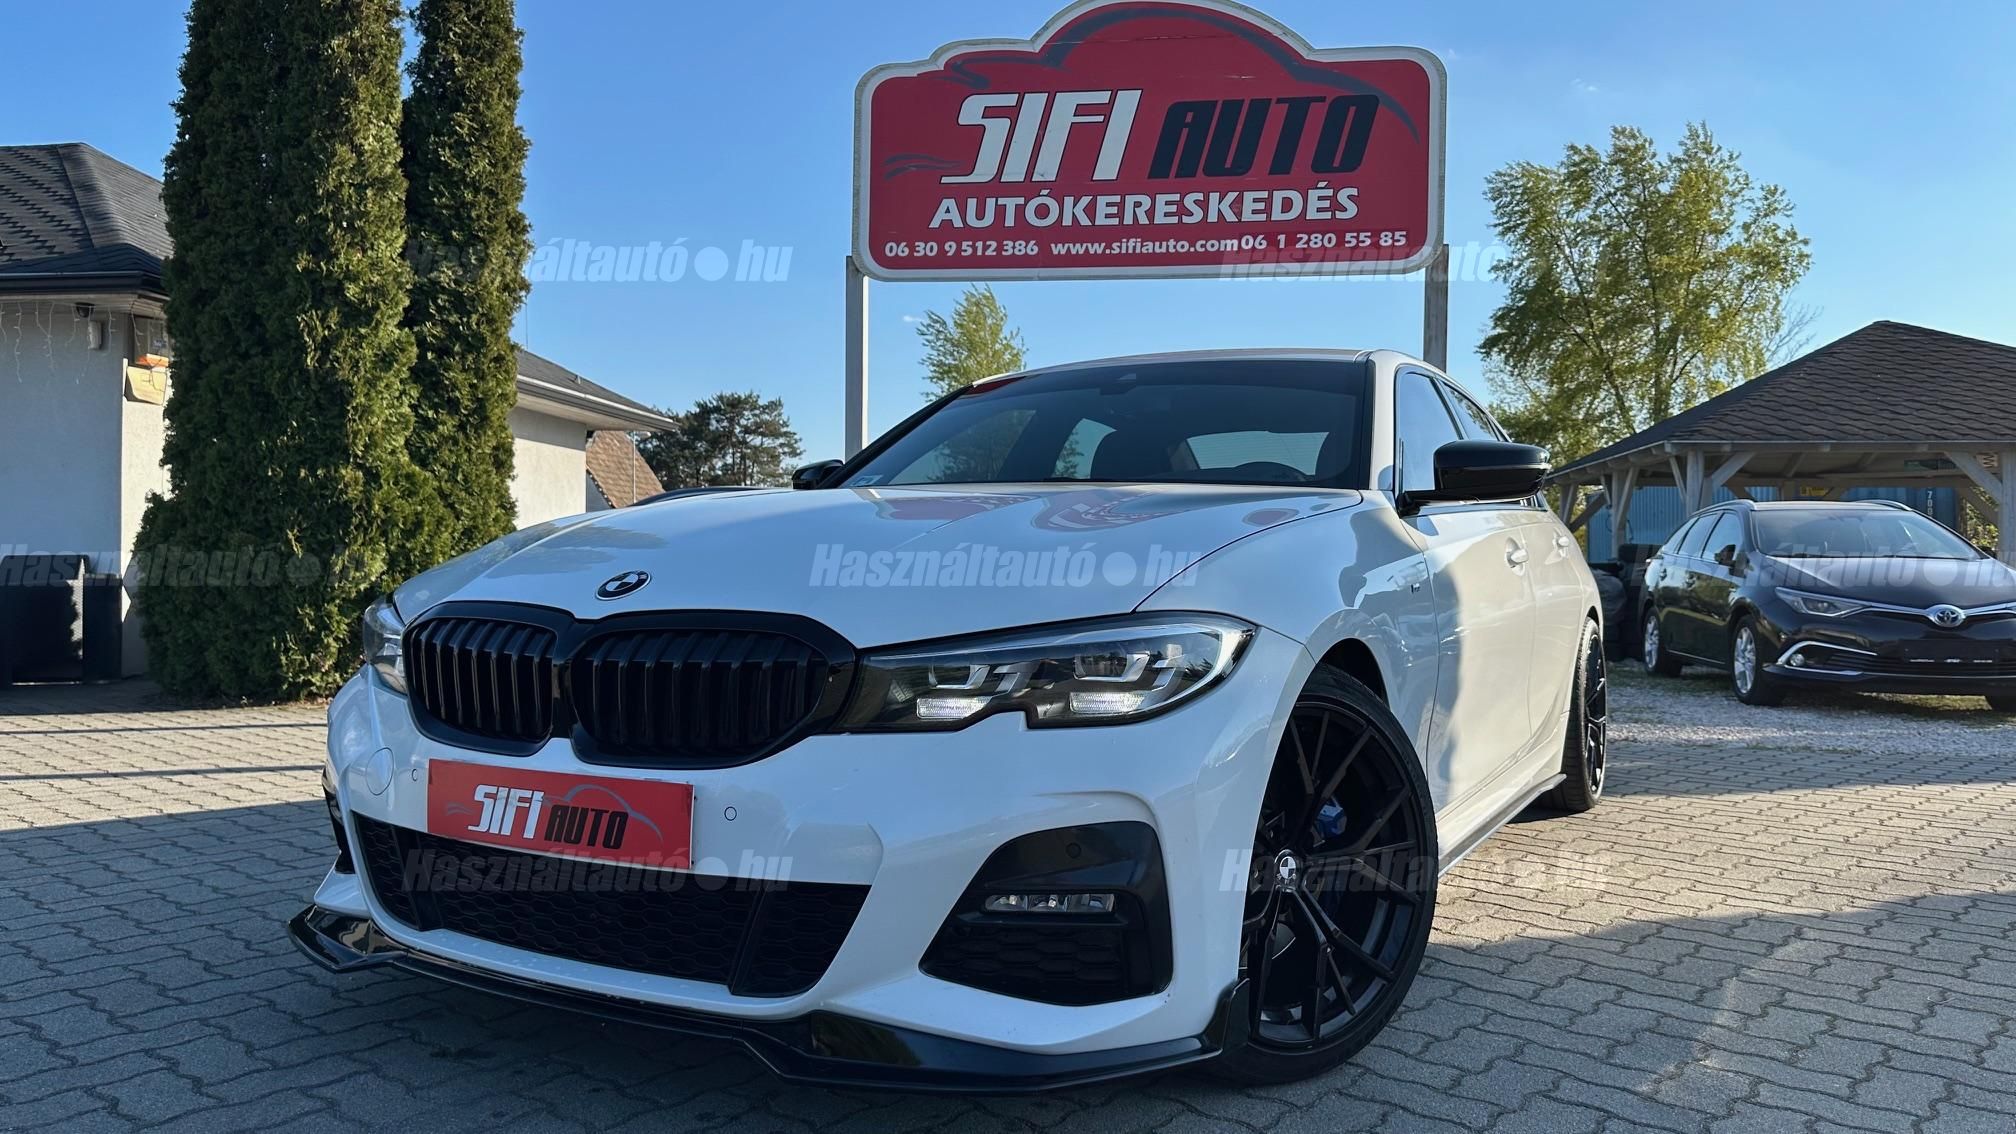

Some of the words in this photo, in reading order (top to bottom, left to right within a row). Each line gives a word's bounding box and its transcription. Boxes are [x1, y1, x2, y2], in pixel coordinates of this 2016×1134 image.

[940, 89, 1142, 184] SIFI
[1147, 94, 1380, 180] AUTO
[928, 181, 1360, 229] AUTÓKERESKEDÉS
[885, 241, 909, 257] 06
[914, 241, 938, 257] 30
[944, 241, 956, 257] 9
[961, 240, 997, 256] 512
[1001, 240, 1039, 256] 386
[1051, 237, 1239, 256] www.sifiauto.com
[1241, 234, 1267, 250] 06
[1277, 234, 1287, 249] 1
[1296, 233, 1337, 249] 280
[1344, 232, 1372, 248] 55
[1379, 231, 1407, 247] 85
[467, 783, 544, 839] SIFI
[544, 804, 629, 850] AUTO
